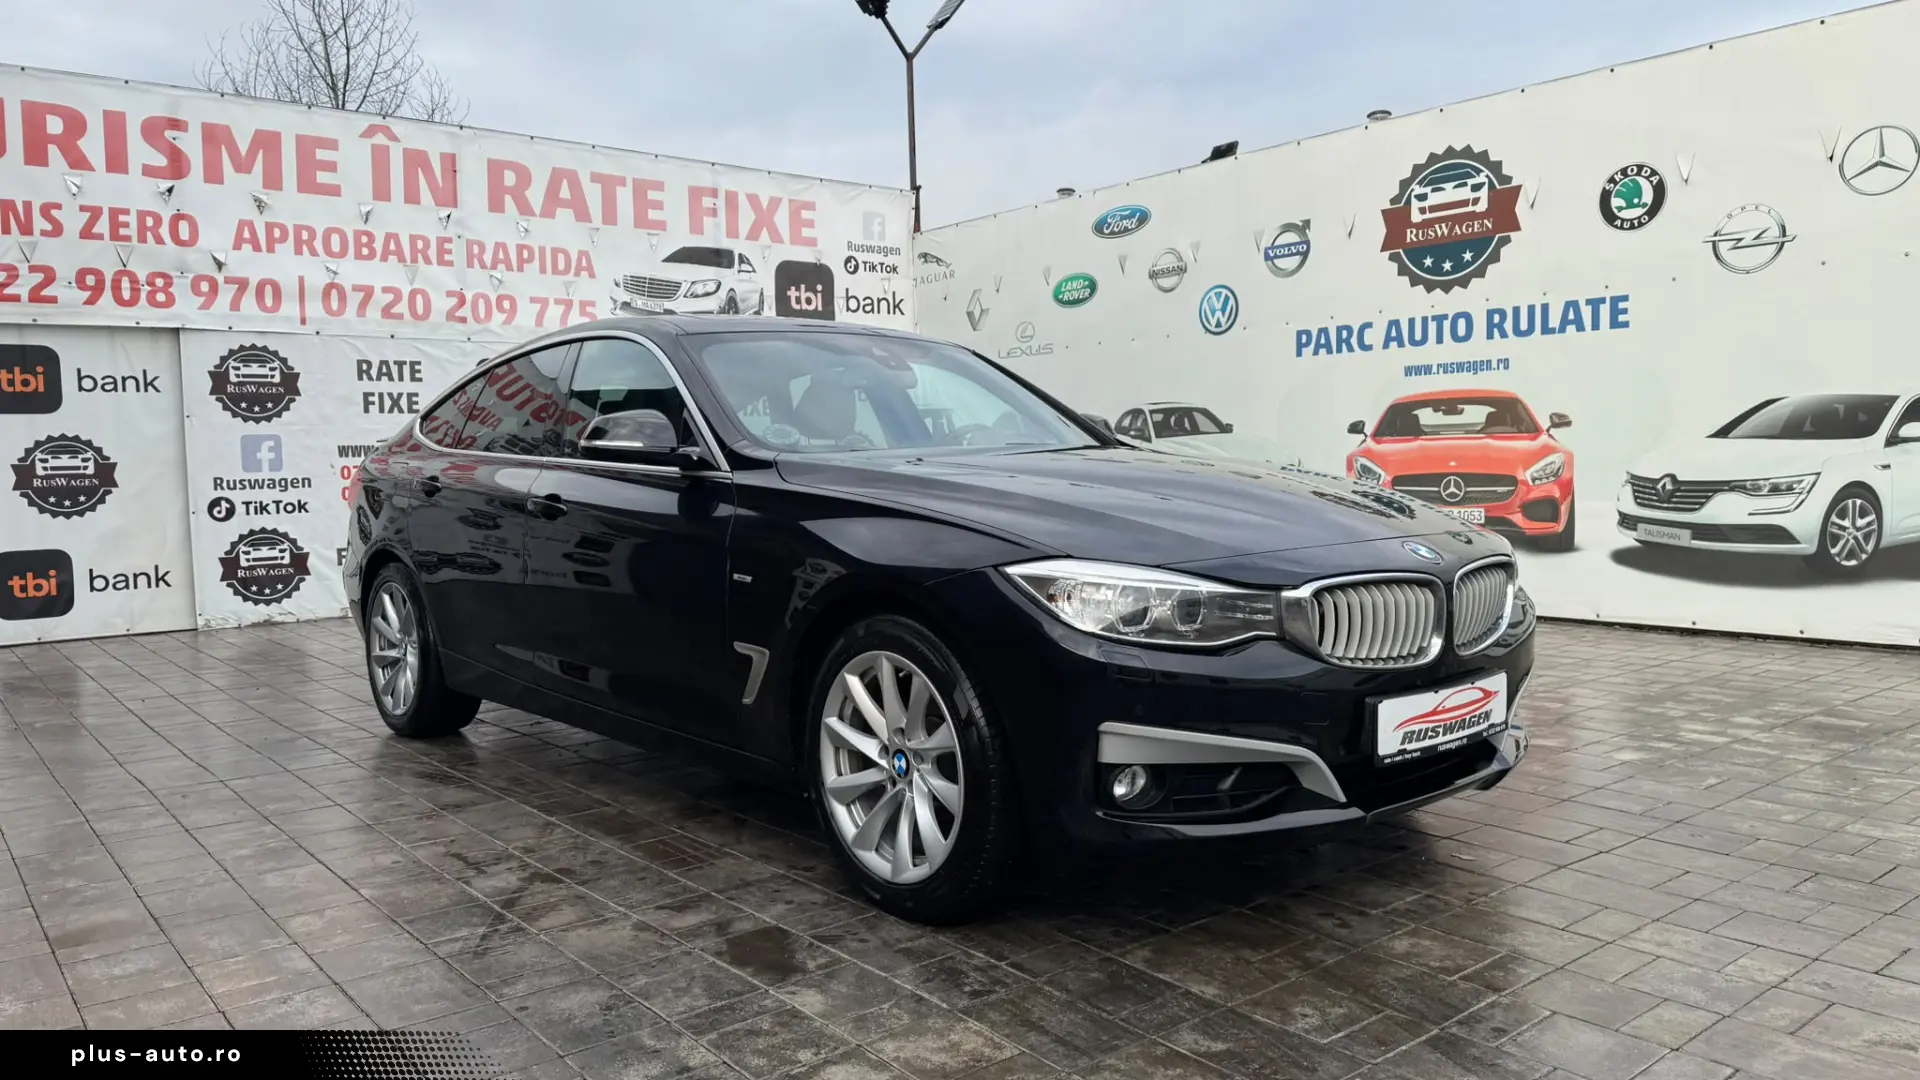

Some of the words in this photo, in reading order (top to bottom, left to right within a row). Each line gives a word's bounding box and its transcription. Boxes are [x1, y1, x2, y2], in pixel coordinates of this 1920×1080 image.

[358, 123, 458, 209] ÎN
[487, 158, 668, 233] RATE
[687, 185, 818, 248] FIXE
[1103, 209, 1140, 234] Ford
[1613, 215, 1649, 229] AUTO
[1726, 204, 1771, 219] OPEL
[79, 204, 200, 248] ZERO
[232, 218, 454, 267] APROBARE
[466, 238, 597, 279] RAPIDA
[846, 240, 901, 258] Ruswagen
[1267, 244, 1307, 258] VOLVO
[861, 260, 899, 275] TikTok
[1151, 264, 1184, 277] NISSAN
[911, 269, 956, 288] JAGUAR
[74, 267, 177, 309] 908
[190, 274, 282, 314] 970
[321, 281, 432, 322] 0720
[445, 290, 518, 326] 209
[529, 296, 599, 328] 775
[786, 284, 823, 312] tbi
[845, 288, 905, 316] bank
[1062, 288, 1091, 301] ROVER
[1295, 321, 1374, 358] PARC
[1382, 311, 1475, 350] AUTO
[1486, 294, 1631, 341] RULATE
[997, 343, 1054, 359] LEXUS
[356, 359, 424, 383] RATE
[1403, 357, 1511, 378] www.ruswagen.ro
[0, 366, 45, 393] tbi
[76, 367, 162, 393] bank
[362, 391, 421, 415] FIXE
[213, 476, 312, 493] Ruswagen
[241, 499, 310, 516] TikTok
[1643, 527, 1682, 541] TALISMAN
[8, 569, 58, 599] tbi
[88, 564, 173, 594] bank
[1400, 708, 1493, 747] RUSWAGEN
